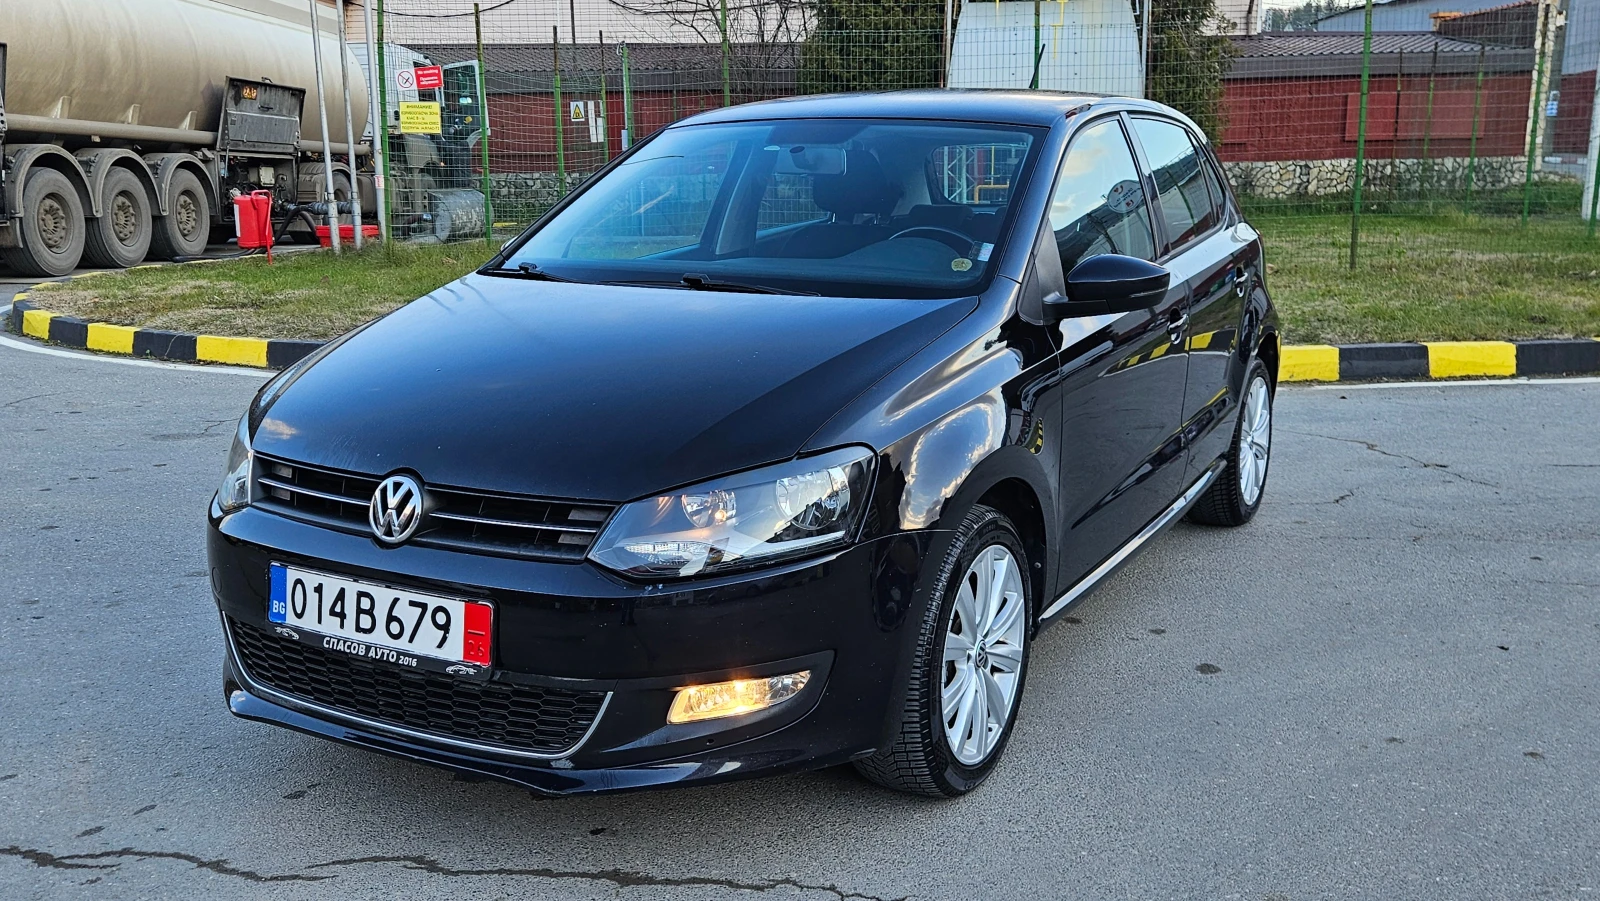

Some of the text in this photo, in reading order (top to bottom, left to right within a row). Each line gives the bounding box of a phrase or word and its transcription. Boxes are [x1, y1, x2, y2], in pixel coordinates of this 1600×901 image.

[272, 600, 286, 615] BG
[290, 577, 452, 650] 014B679
[323, 636, 418, 667] СПАСОВ АУТО 2016
